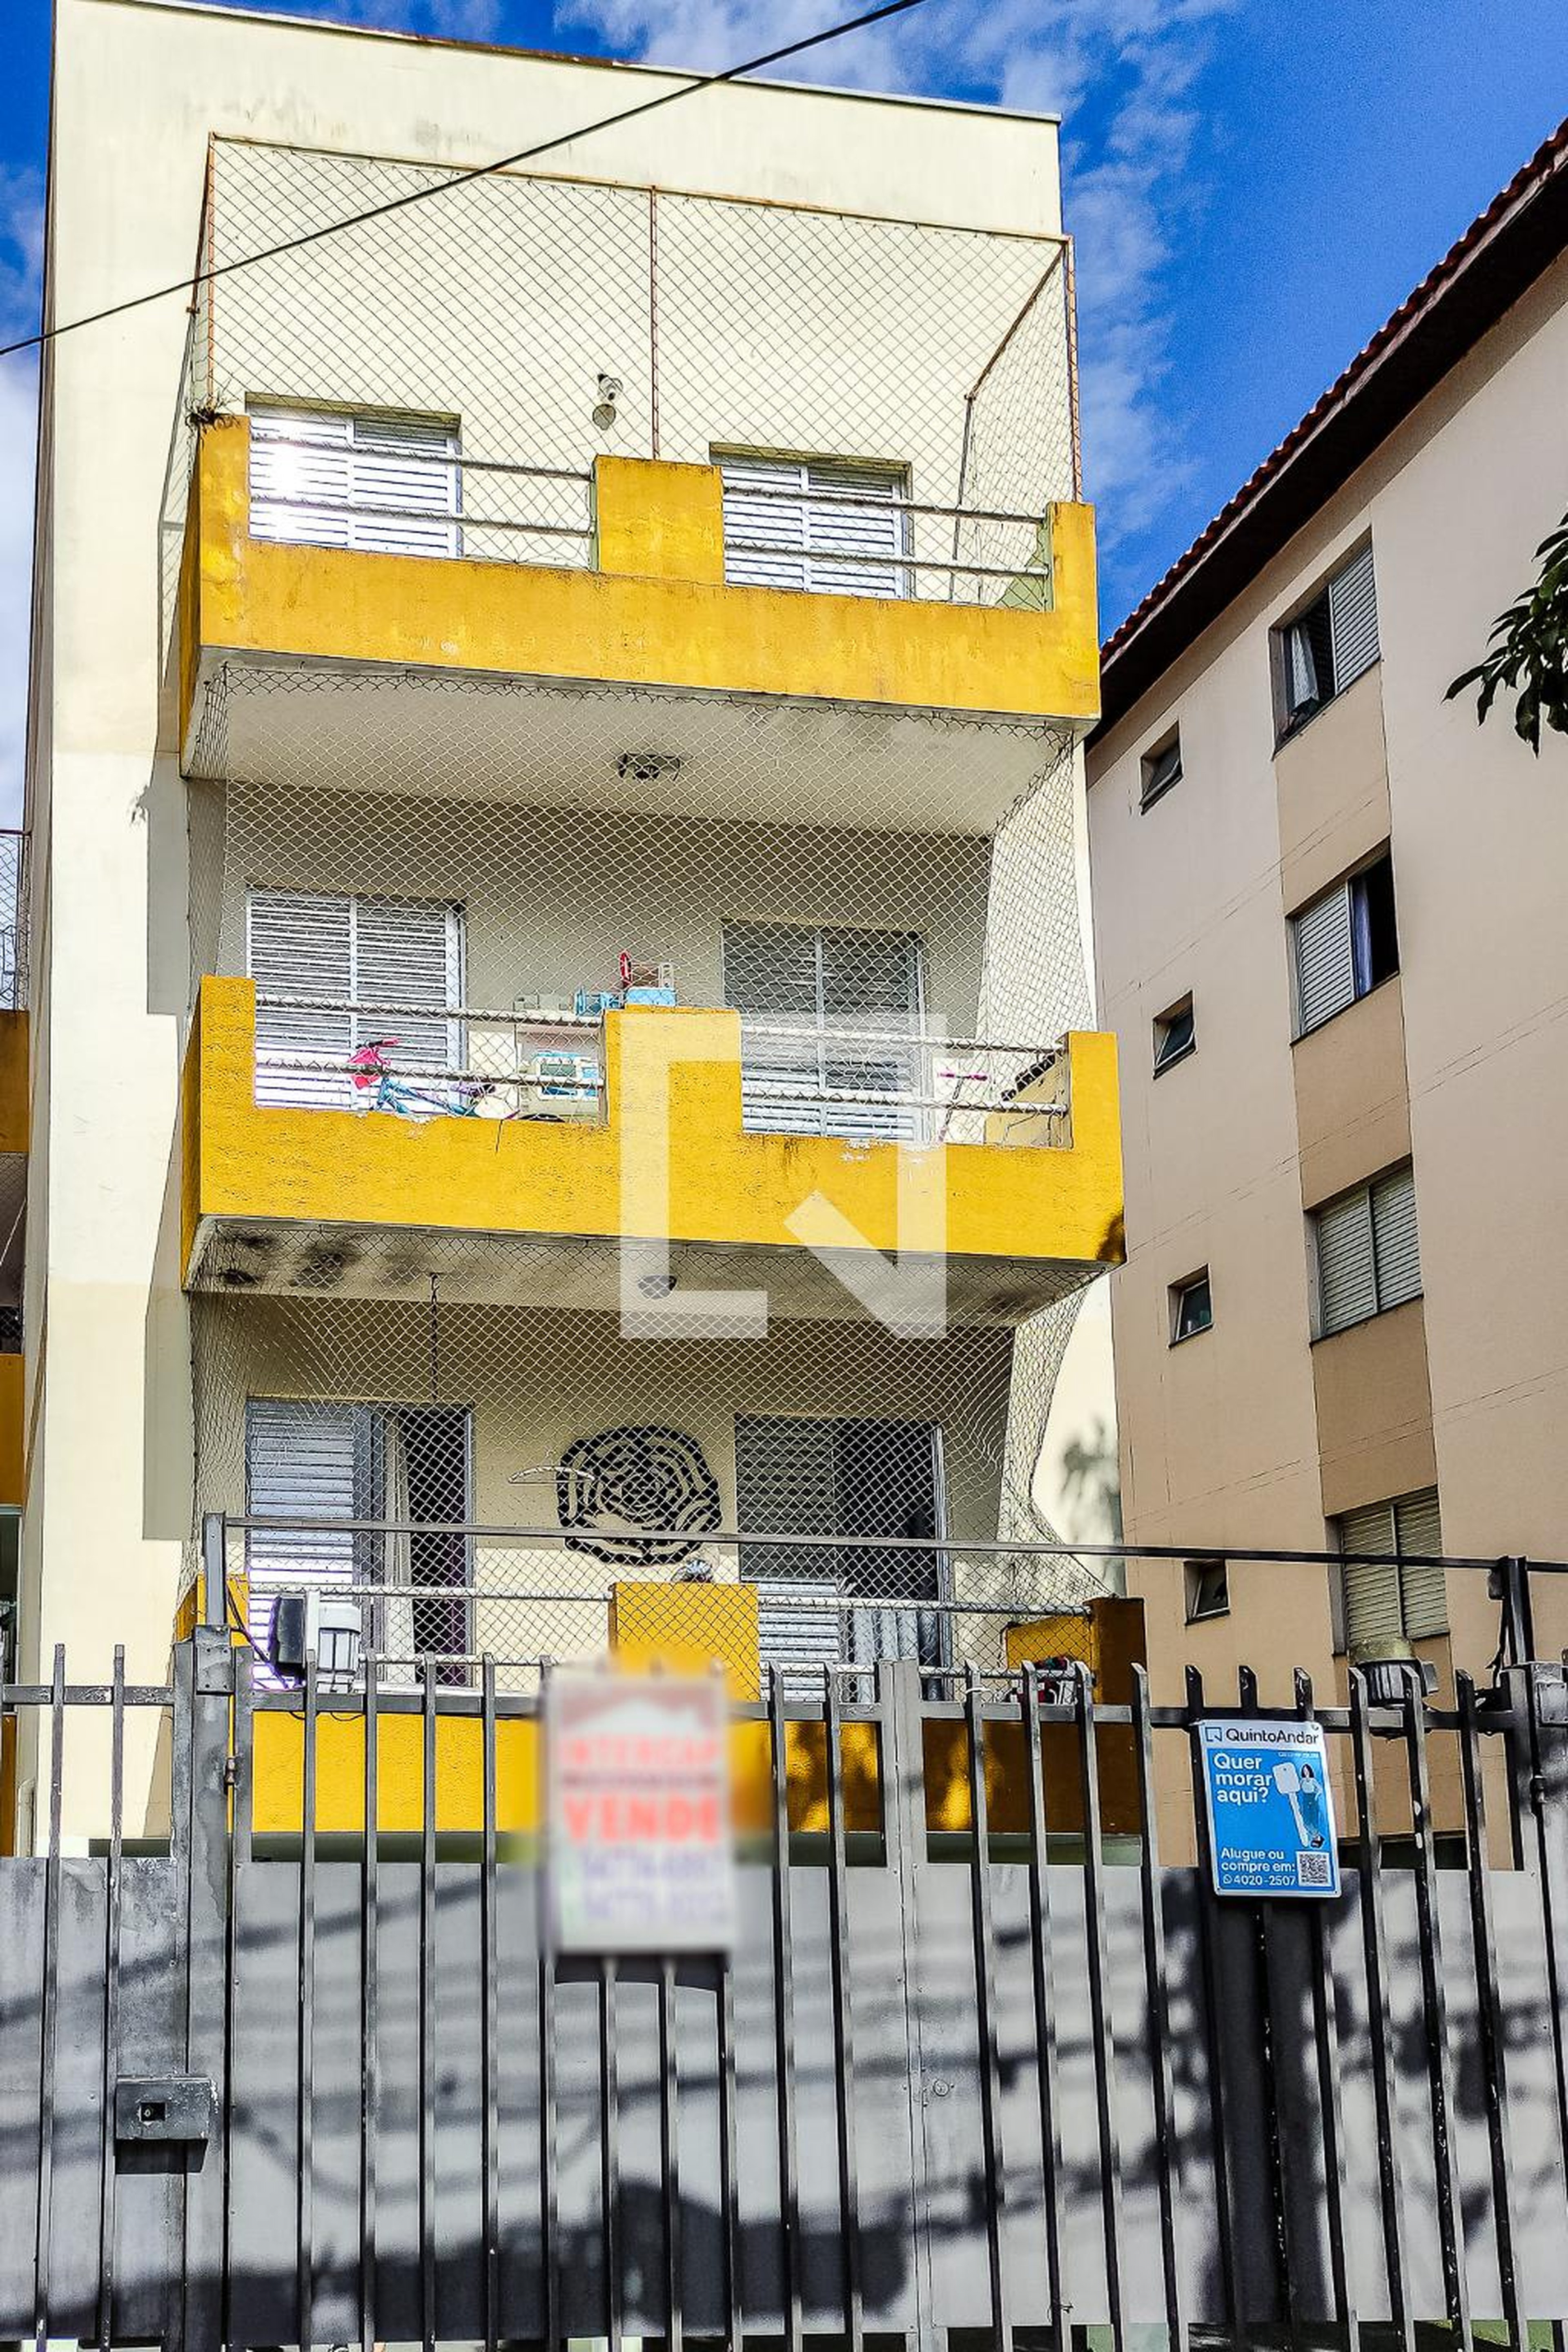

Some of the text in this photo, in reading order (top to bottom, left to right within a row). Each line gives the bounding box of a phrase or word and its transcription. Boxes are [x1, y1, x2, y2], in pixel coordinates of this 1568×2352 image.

[1226, 1728, 1319, 1744] QuintoAndar
[1214, 1753, 1262, 1769] Quer
[1215, 1773, 1272, 1786] morar
[1217, 1786, 1268, 1806] aqui?
[1221, 1847, 1284, 1861] Alugue ou
[1221, 1862, 1296, 1873] compre em:
